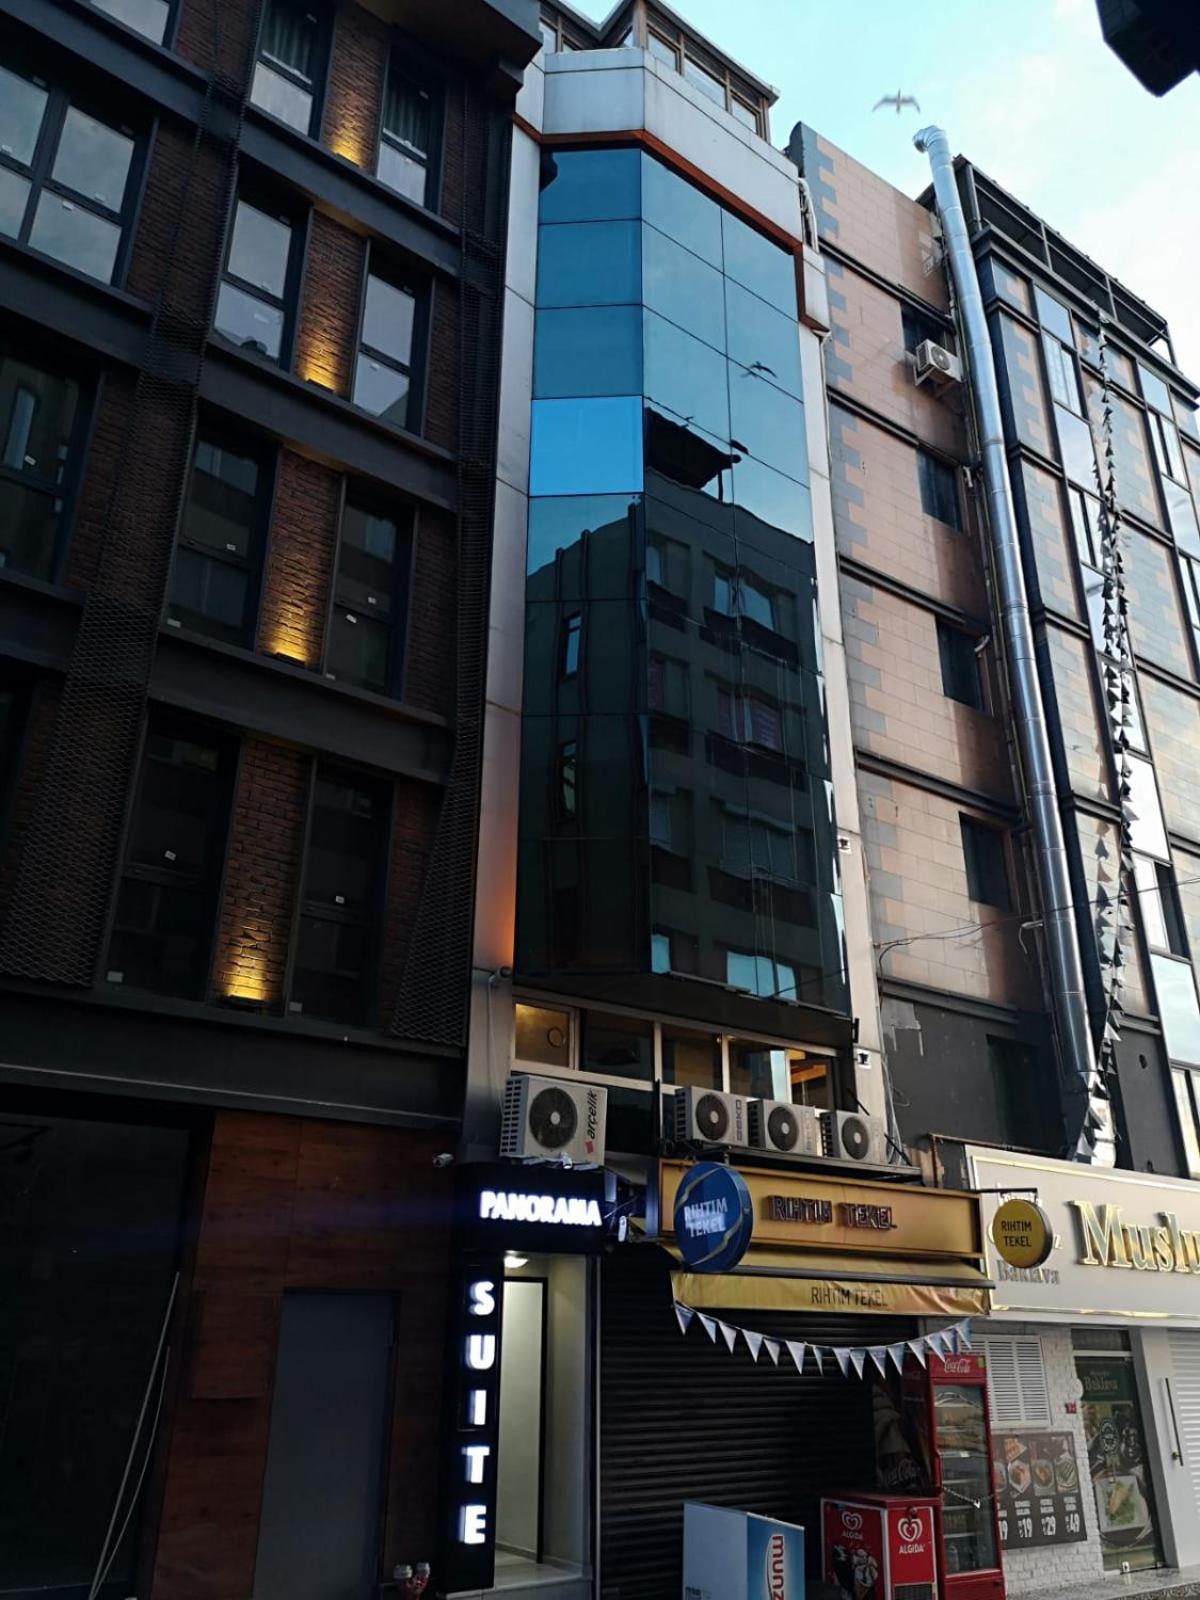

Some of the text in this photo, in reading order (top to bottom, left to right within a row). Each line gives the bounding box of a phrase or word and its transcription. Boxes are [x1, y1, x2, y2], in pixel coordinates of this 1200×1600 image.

[480, 1190, 602, 1226] PANORAMA
[684, 1197, 728, 1222] RIHTIM
[838, 1202, 898, 1231] TEKEL
[686, 1213, 726, 1238] TEKEL
[1001, 1220, 1033, 1232] RIHTIM
[1003, 1235, 1033, 1248] TEKEL
[811, 1286, 889, 1308] RIHTIM TEKEL
[459, 1281, 496, 1545] SUITE
[842, 1530, 864, 1540] ALGIDA
[899, 1544, 924, 1554] ALGIDA
